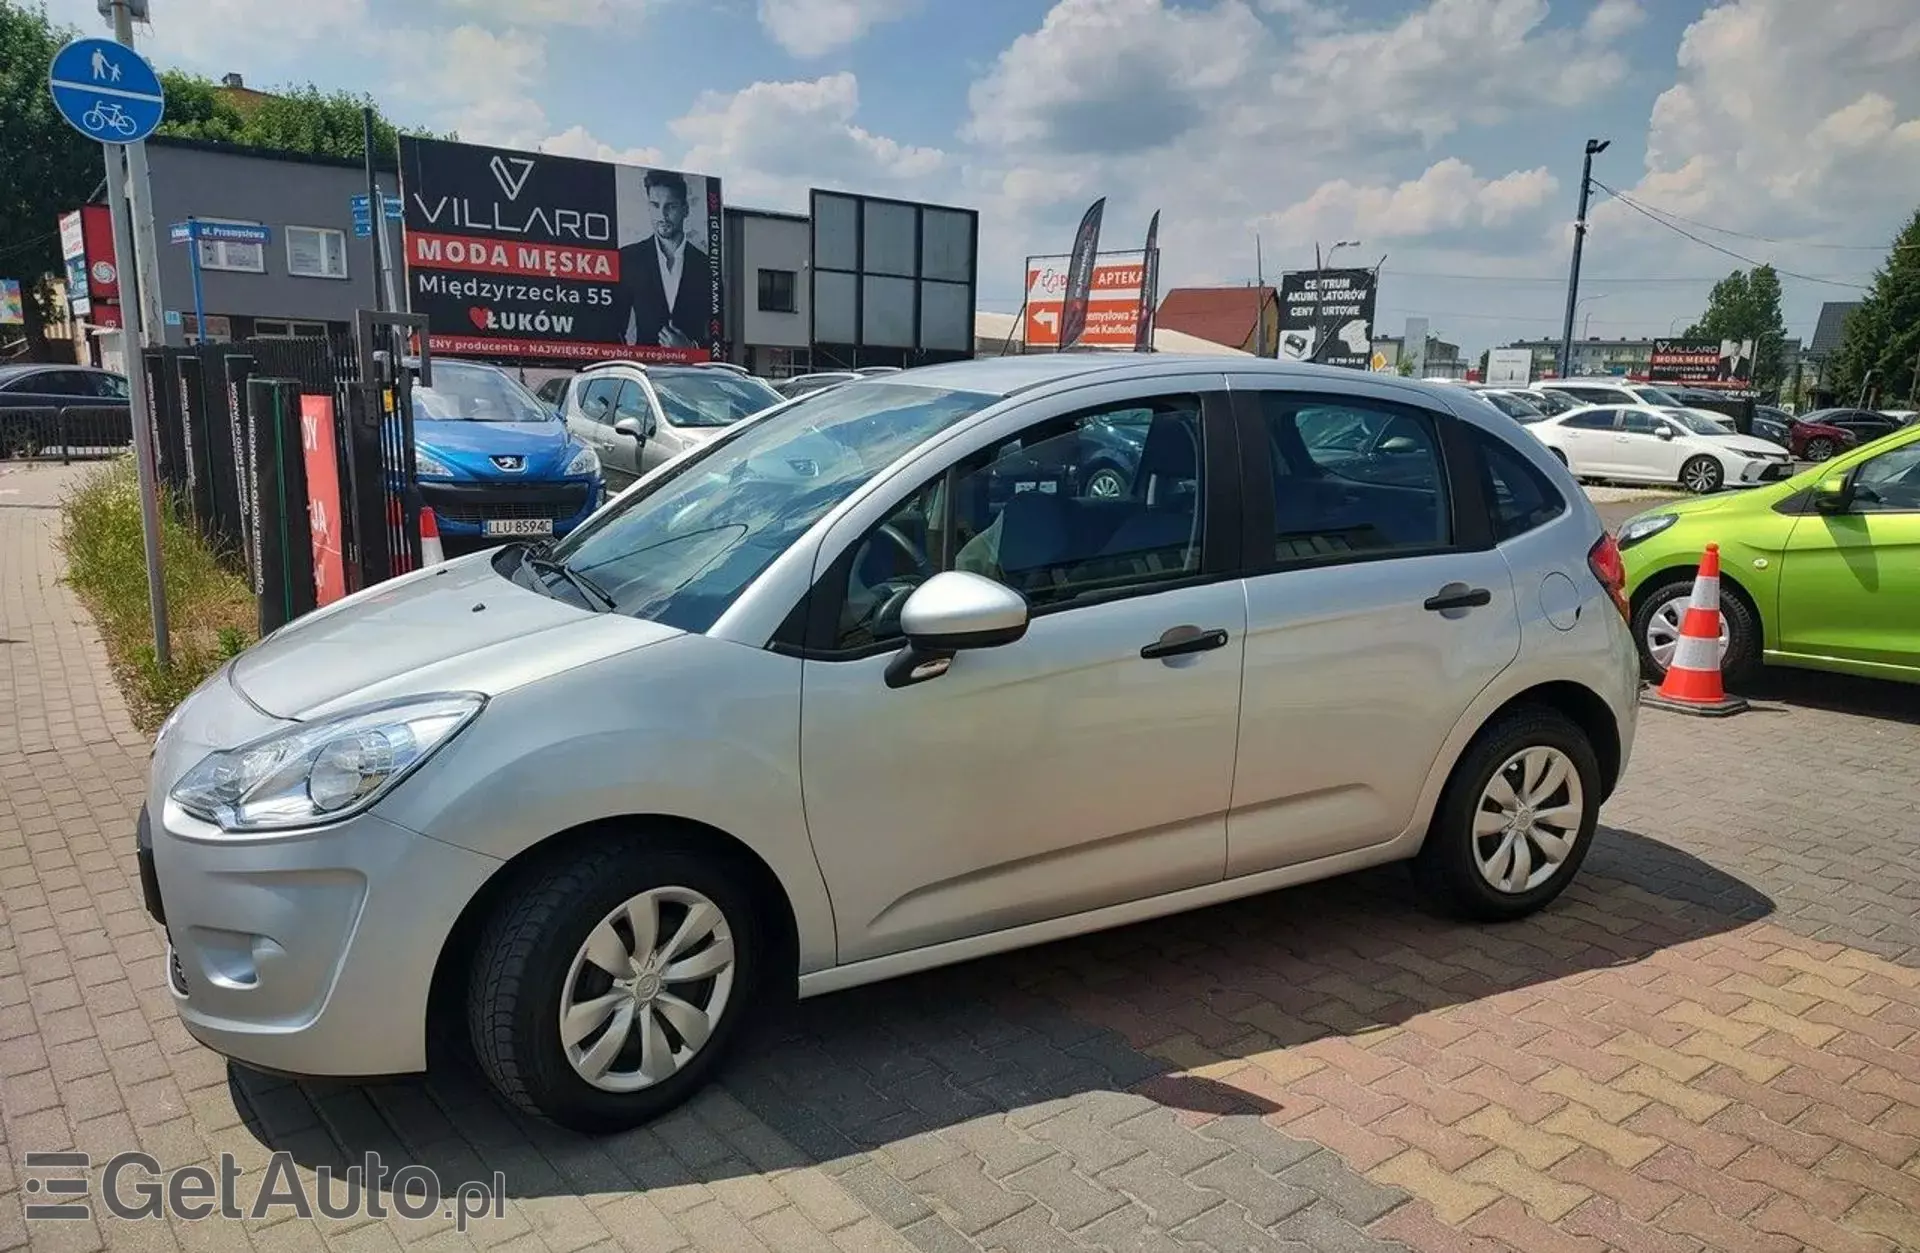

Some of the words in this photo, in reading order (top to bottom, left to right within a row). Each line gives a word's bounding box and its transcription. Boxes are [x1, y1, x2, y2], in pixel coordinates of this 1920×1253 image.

[413, 192, 610, 241] VILLARO
[417, 238, 509, 268] MODA
[518, 247, 612, 277] MĘSKA
[709, 215, 720, 315] www.villaro.pl
[419, 274, 580, 303] Międzyrzecka
[587, 288, 613, 306] 55
[486, 309, 574, 333] ŁUKÓW
[1290, 306, 1315, 316] CENY
[1321, 305, 1361, 316] URTOWE
[429, 338, 452, 349] ENY
[455, 340, 519, 353] producenta
[529, 344, 600, 357] NAJWIĘKSZY
[602, 346, 633, 358] wybór
[646, 350, 687, 361] regionie
[1655, 355, 1684, 364] MODA
[1667, 345, 1719, 355] VILLARO
[489, 521, 512, 534] LLU
